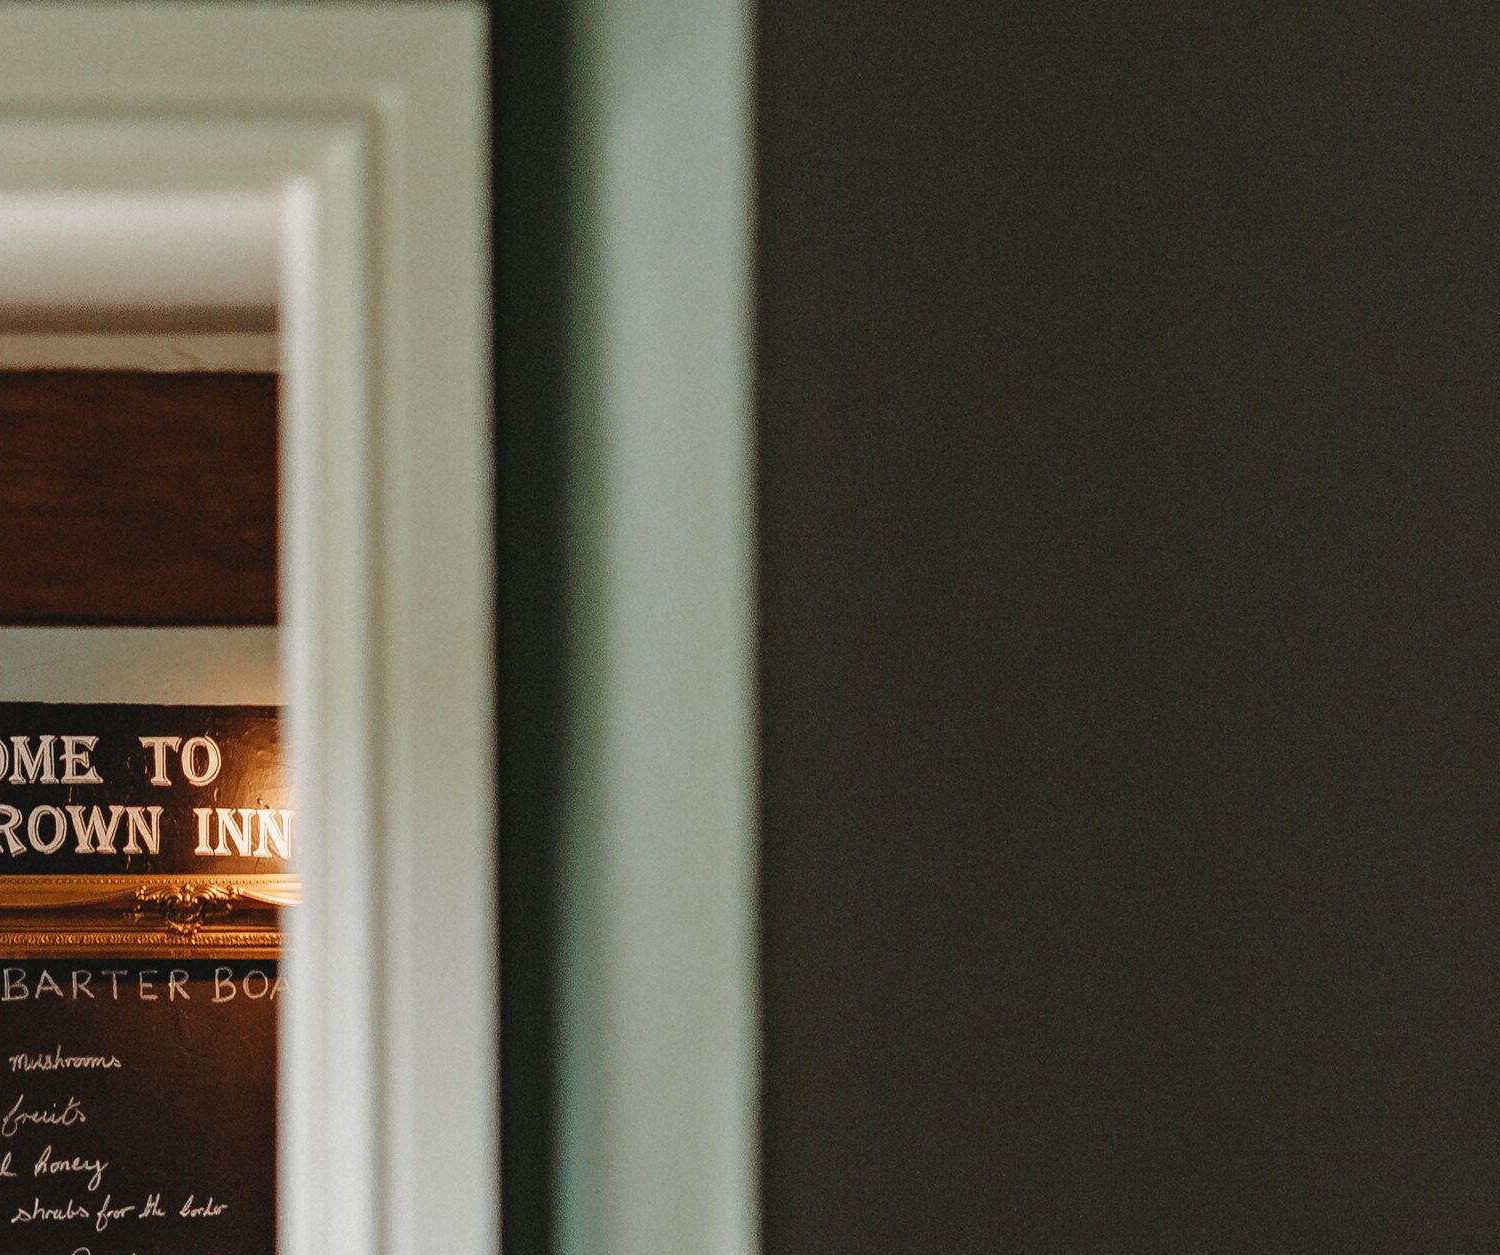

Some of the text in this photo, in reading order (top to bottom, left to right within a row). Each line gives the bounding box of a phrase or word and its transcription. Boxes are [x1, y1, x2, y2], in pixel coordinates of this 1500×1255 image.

[138, 733, 223, 787] TO
[192, 806, 296, 860] INN
[1, 967, 192, 1003] BARTER
[8, 1044, 123, 1071] mushrooms
[1, 1094, 87, 1138] fruits
[33, 1145, 109, 1191] honey
[10, 1196, 90, 1224] shrubs
[138, 1193, 167, 1219] the
